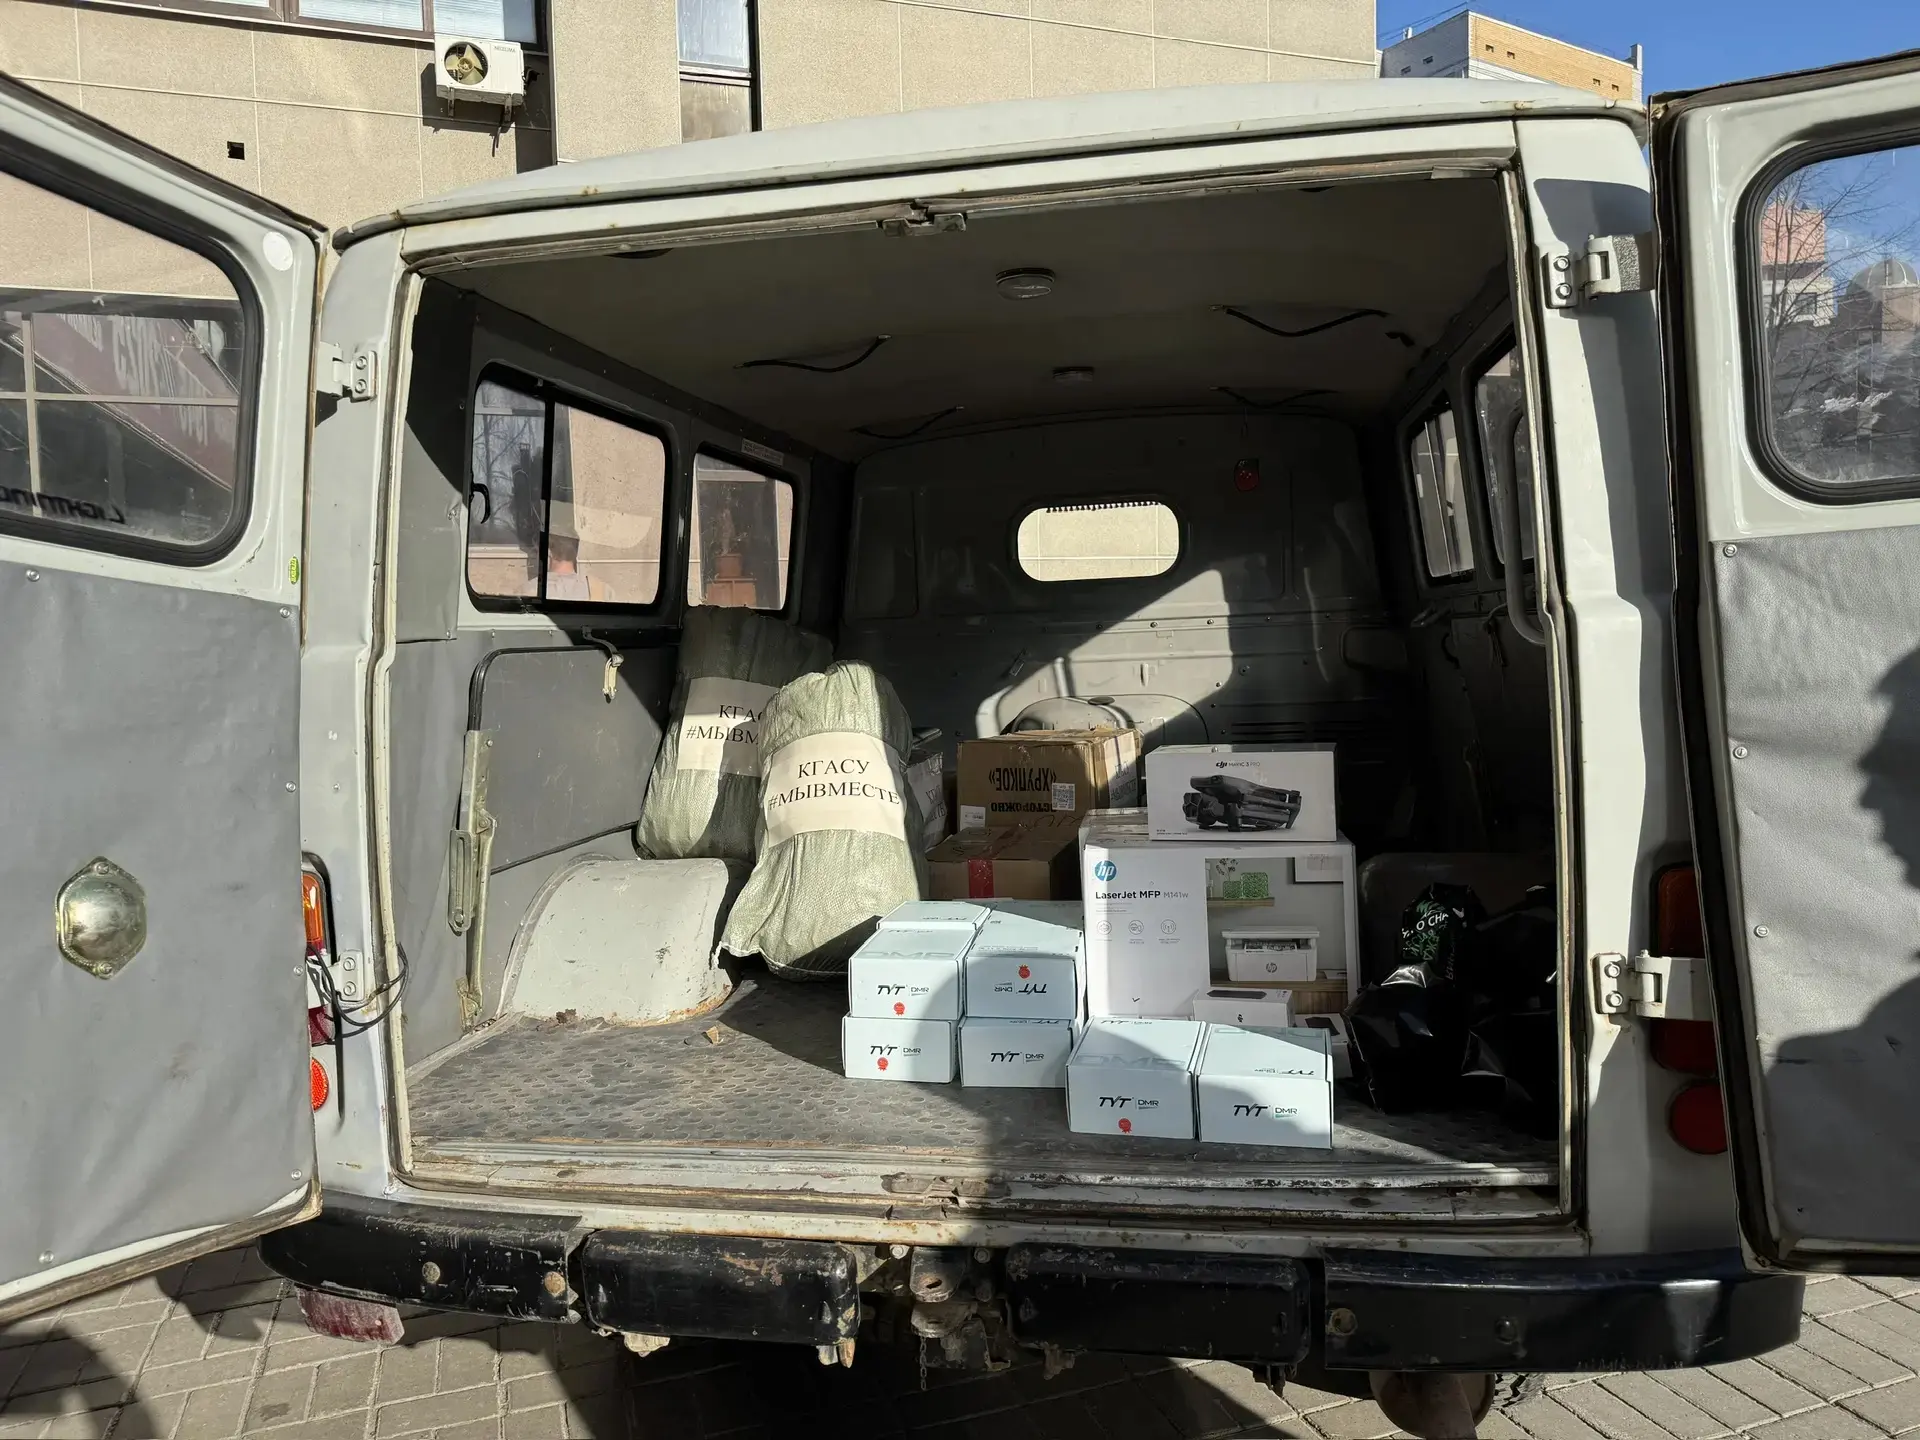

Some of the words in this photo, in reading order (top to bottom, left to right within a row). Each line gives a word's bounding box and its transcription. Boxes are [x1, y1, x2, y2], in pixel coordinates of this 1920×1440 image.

[798, 758, 871, 779] КГАСУ
[768, 781, 900, 811] #МЫВМЕСТЕ
[1095, 860, 1117, 882] hp
[1095, 890, 1137, 899] LaserJet
[1139, 890, 1161, 899] MFP
[1163, 891, 1189, 899] M141w
[877, 983, 905, 995] TYT
[1018, 983, 1047, 995] TYT
[870, 1044, 898, 1056] TYT
[990, 1050, 1020, 1063] TYT
[1099, 1095, 1132, 1109] TYT
[1233, 1103, 1269, 1117] TYT
